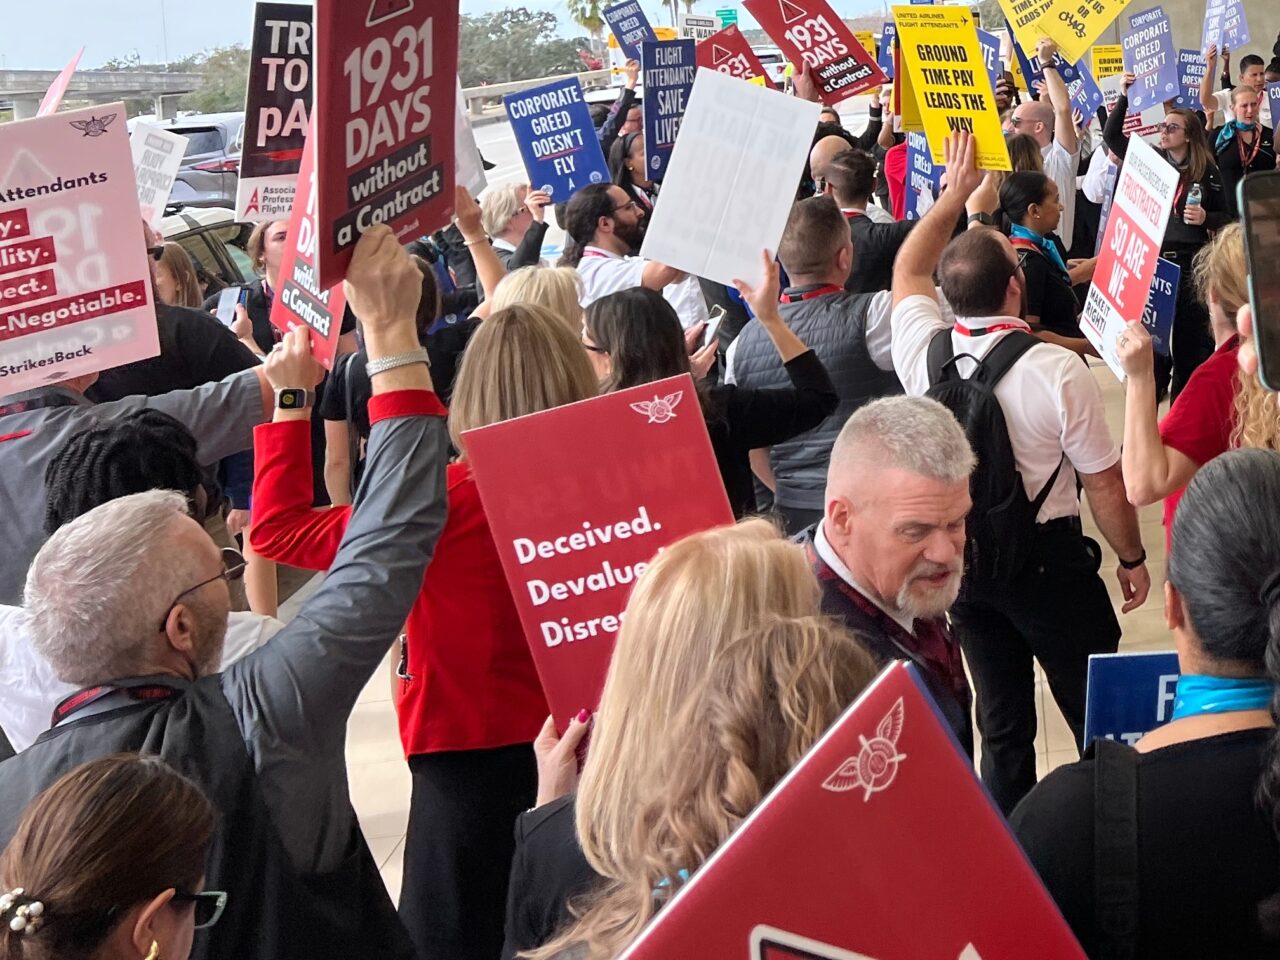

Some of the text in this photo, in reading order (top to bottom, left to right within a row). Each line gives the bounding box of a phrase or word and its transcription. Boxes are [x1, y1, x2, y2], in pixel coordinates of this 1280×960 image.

[606, 2, 640, 24] CORPORATE
[1012, 0, 1033, 15] TIME
[1016, 9, 1041, 28] LEADS
[1077, 5, 1090, 19] OR
[1092, 1, 1106, 14] US
[1131, 9, 1163, 27] CORPORATE
[619, 16, 640, 32] GREED
[621, 26, 648, 44] DOESN'T
[683, 27, 694, 37] WE
[784, 14, 837, 51] 1931
[1058, 10, 1087, 38] CHAOS
[1124, 20, 1169, 50] CORPORATE
[265, 19, 313, 55] TR
[655, 46, 682, 66] FLIGHT
[801, 37, 848, 69] DAYS
[916, 44, 968, 62] GROUND
[1135, 40, 1161, 60] GREED
[261, 57, 308, 92] TO
[343, 16, 433, 114] 1931
[717, 53, 750, 76] 931
[820, 56, 857, 79] without
[1133, 52, 1166, 76] DOESN'T
[646, 66, 695, 89] ATTENDANTS
[823, 85, 833, 93] a
[830, 66, 872, 89] Contract
[921, 68, 975, 87] TIME PAY
[1144, 72, 1158, 89] FLY
[509, 85, 581, 119] CORPORATE
[657, 88, 684, 116] SAVE
[924, 91, 987, 111] LEADS THE
[257, 98, 309, 147] pA
[345, 85, 432, 168] DAYS
[531, 110, 572, 135] GREED
[946, 116, 973, 134] WAY
[531, 128, 584, 158] DOESN'T
[351, 143, 428, 202] without
[553, 155, 576, 176] FLY
[262, 204, 285, 214] Flight
[337, 223, 352, 246] a
[356, 169, 440, 234] Contract
[1110, 217, 1149, 279] SO ARE
[1107, 260, 1129, 308] WE.
[282, 288, 330, 337] a Contract
[1090, 290, 1111, 318] MAKE IT
[1085, 300, 1107, 335] RIGHT!
[512, 506, 662, 565] Deceived.
